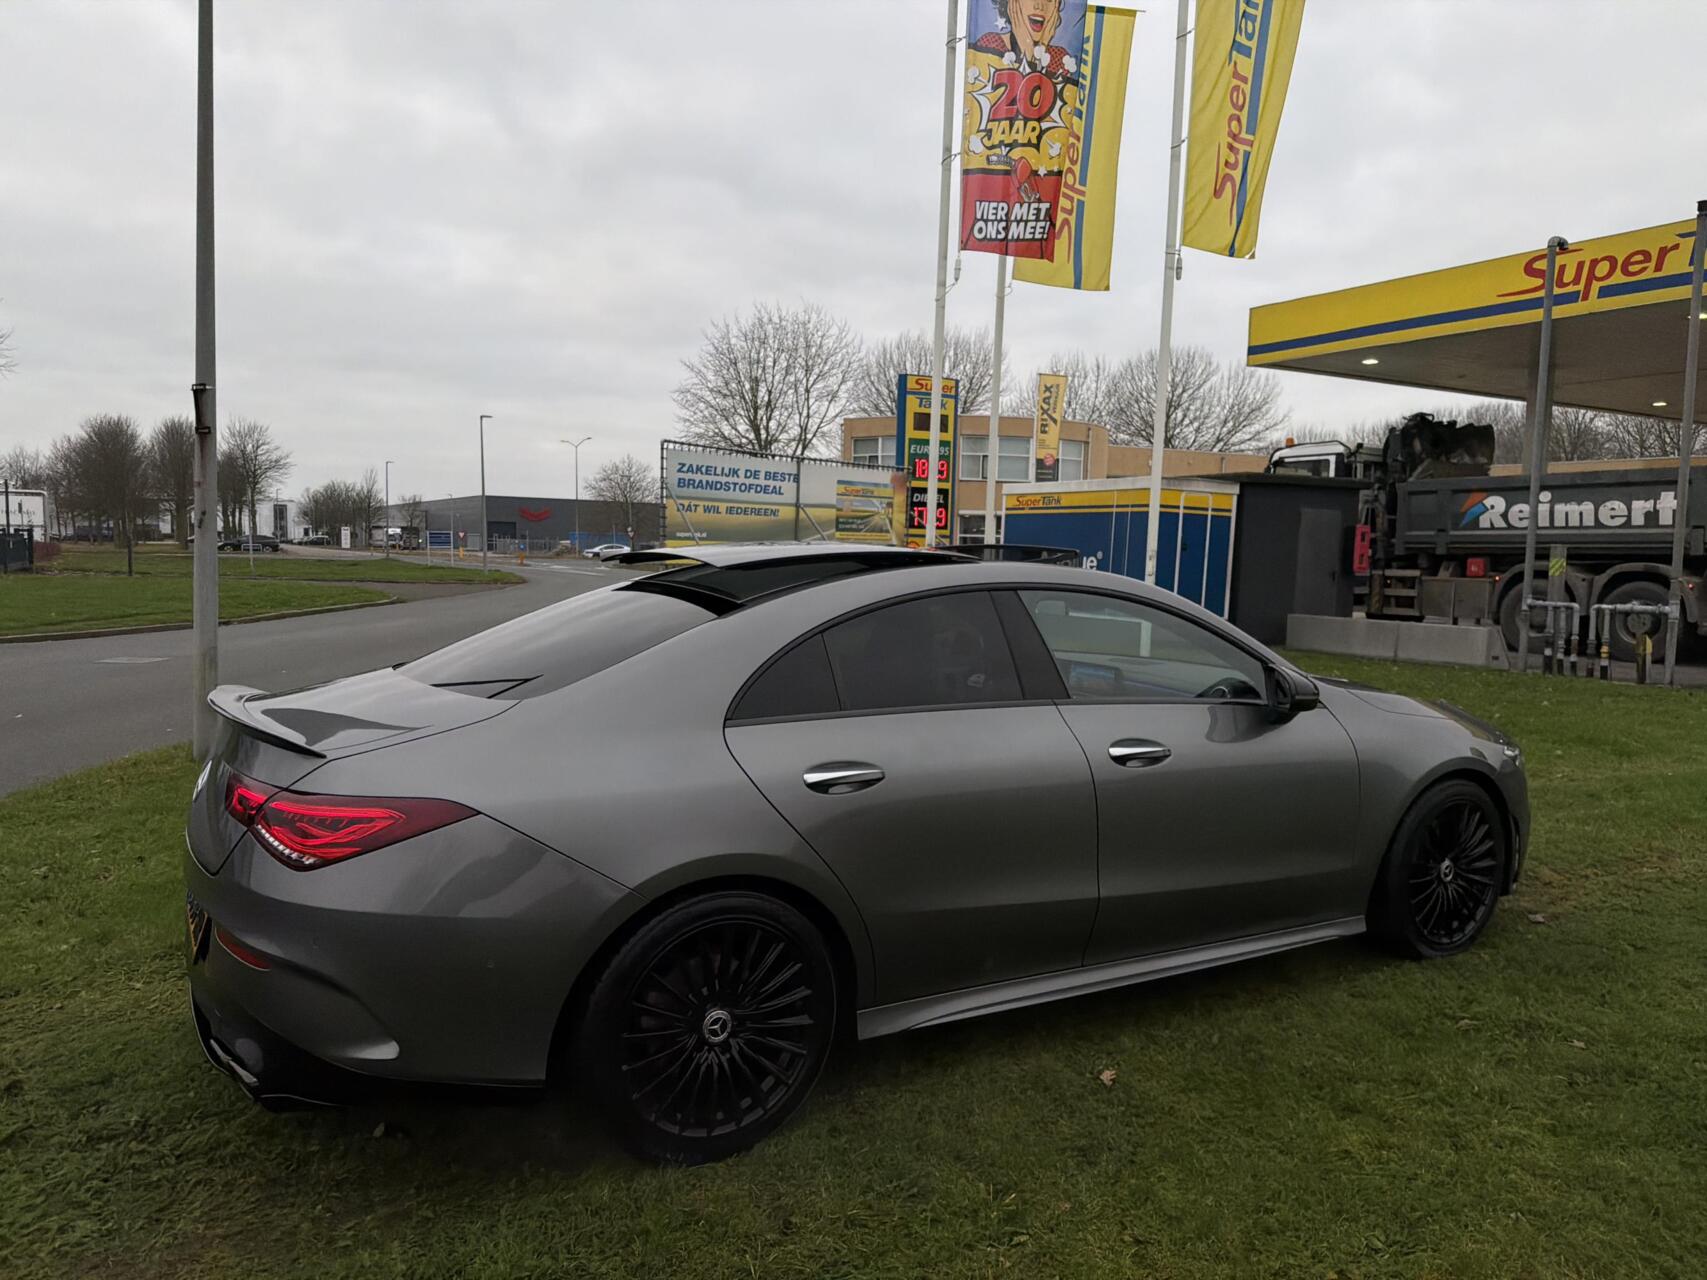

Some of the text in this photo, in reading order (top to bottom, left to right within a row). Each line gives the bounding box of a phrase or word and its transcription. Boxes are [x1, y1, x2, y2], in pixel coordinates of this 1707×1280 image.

[989, 70, 1056, 120] 20
[985, 120, 1041, 146] JAAR
[975, 201, 1050, 221] VIER MET
[973, 221, 1050, 241] ONS MEE!
[909, 377, 955, 394] Suer
[914, 397, 949, 410] Tak
[910, 444, 932, 455] EUR
[676, 462, 799, 484] ZAKELIJK DE BESTE
[914, 459, 948, 480] 189
[676, 477, 785, 496] BRANDSTOFDEAL
[912, 492, 945, 504] DIEEL
[1012, 495, 1063, 507] SuperTank
[703, 504, 722, 515] WIL
[725, 506, 781, 518] IEDEREEN!
[913, 507, 946, 528] 179
[1479, 490, 1678, 529] Reimert
